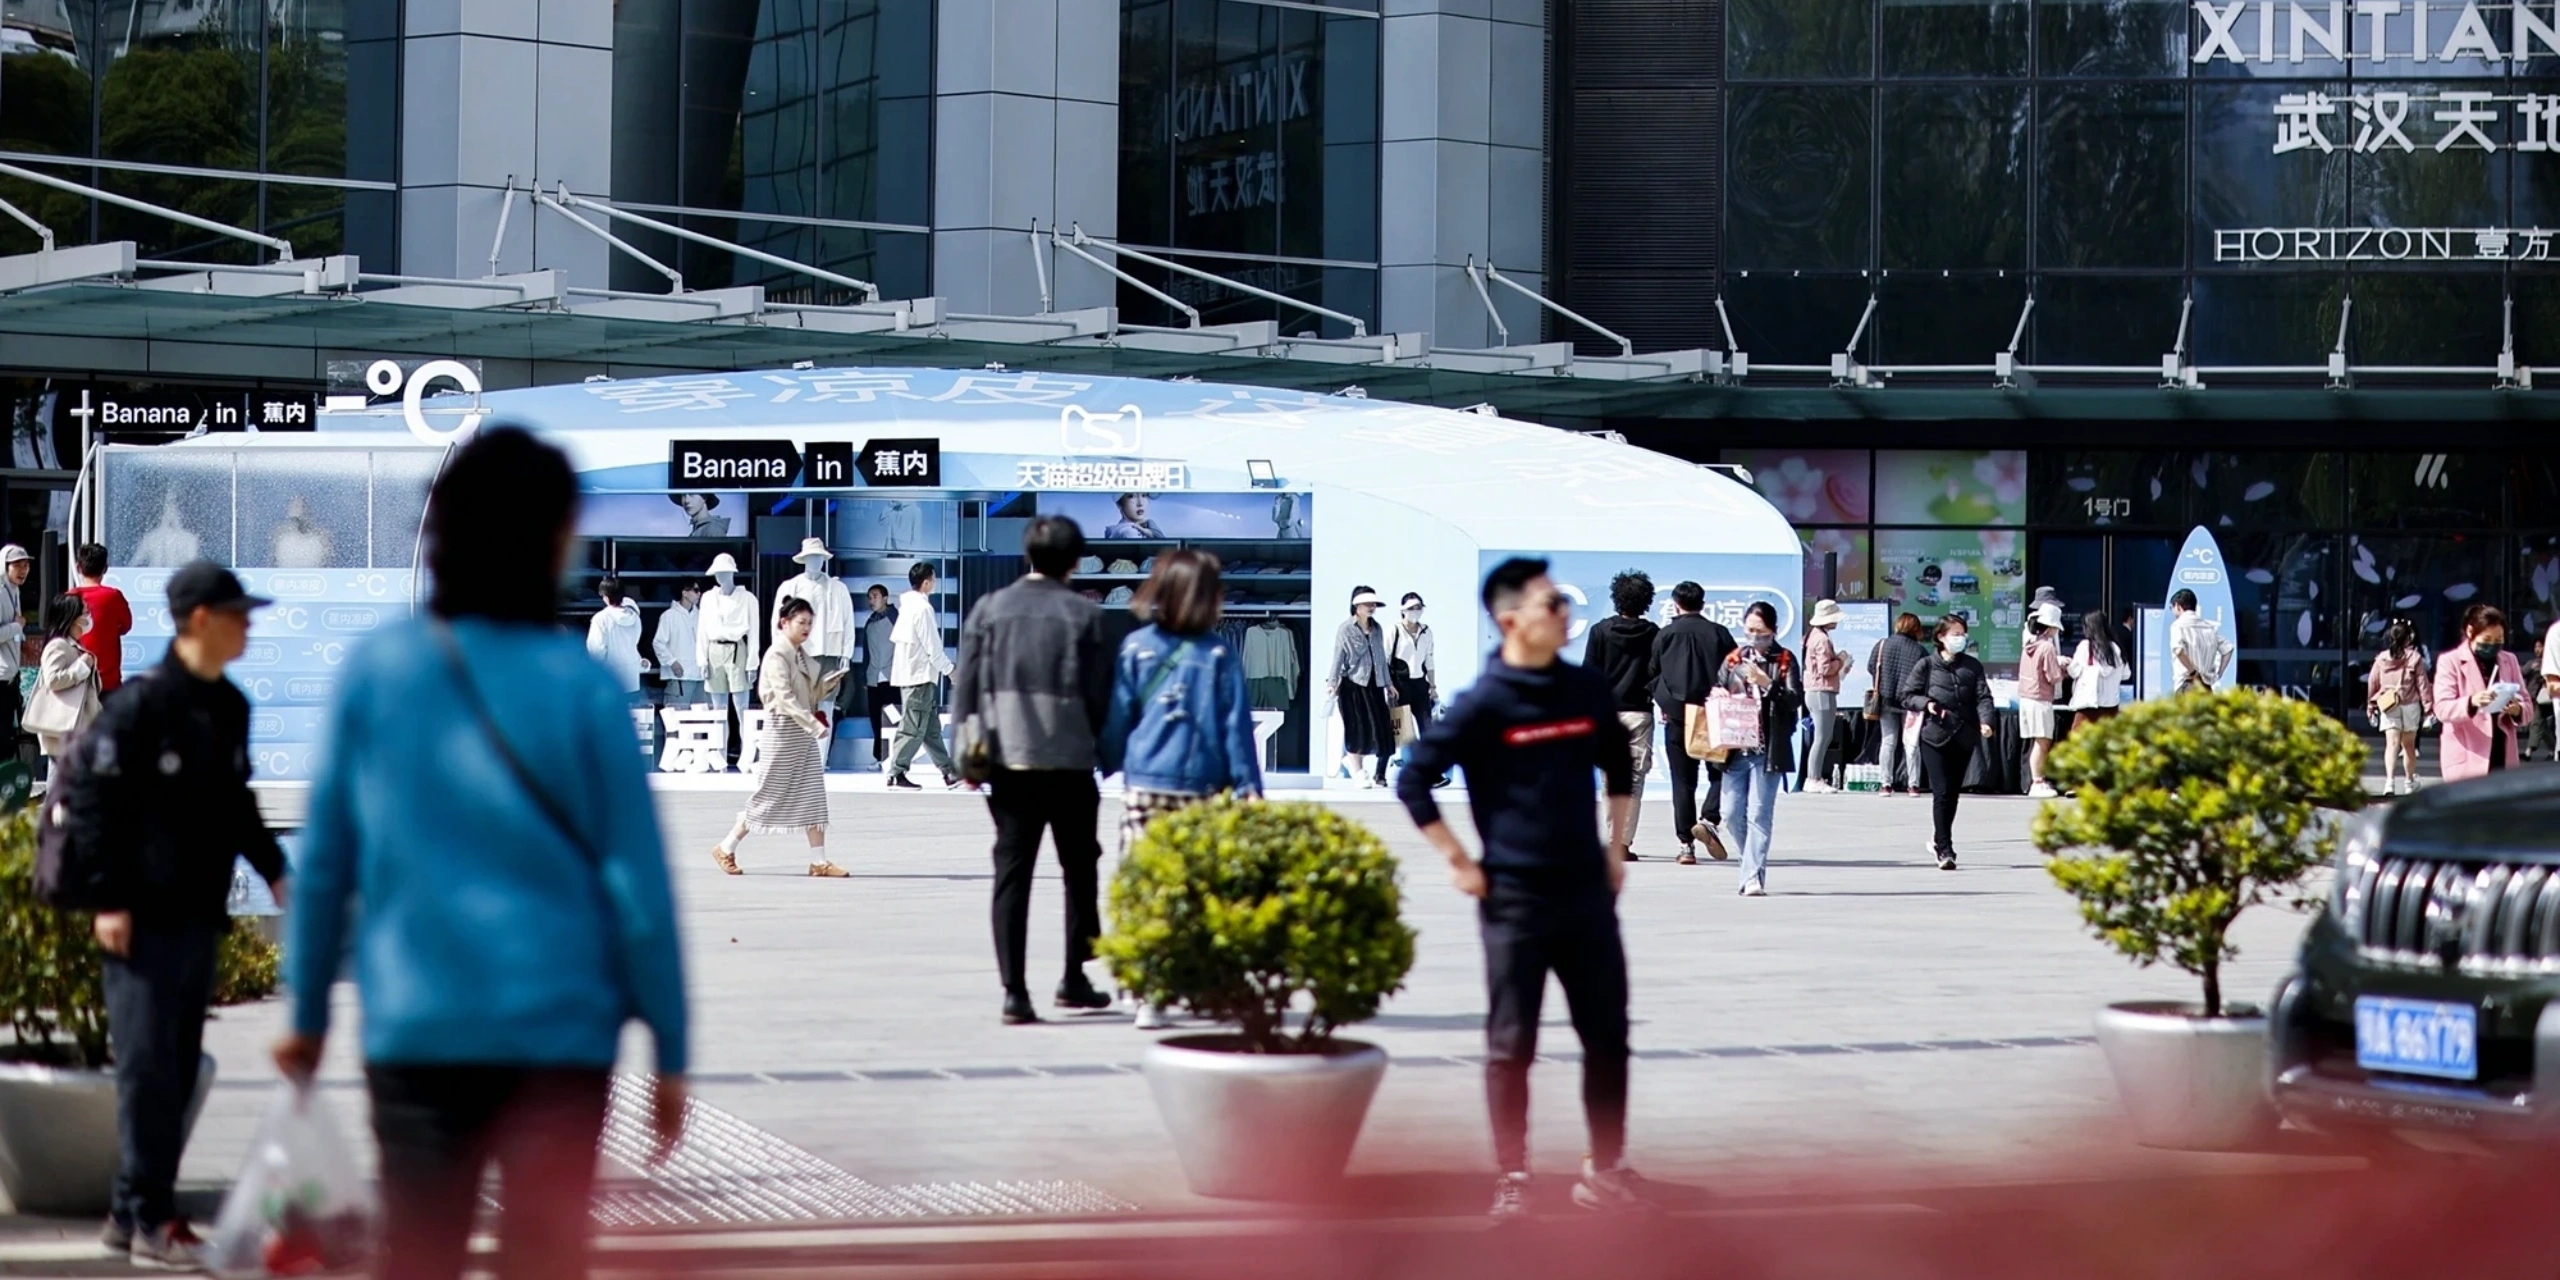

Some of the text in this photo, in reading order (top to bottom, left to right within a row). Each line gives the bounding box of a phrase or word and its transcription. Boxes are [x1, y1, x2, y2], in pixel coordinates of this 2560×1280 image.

[2273, 91, 2560, 154] 武汉天地
[2214, 227, 2450, 262] HORIZON
[102, 401, 306, 424] Banana in 蕉内
[683, 450, 928, 480] Banana in 蕉内
[1016, 461, 1188, 490] 天猫超级品牌日
[2083, 497, 2130, 517] 1号门
